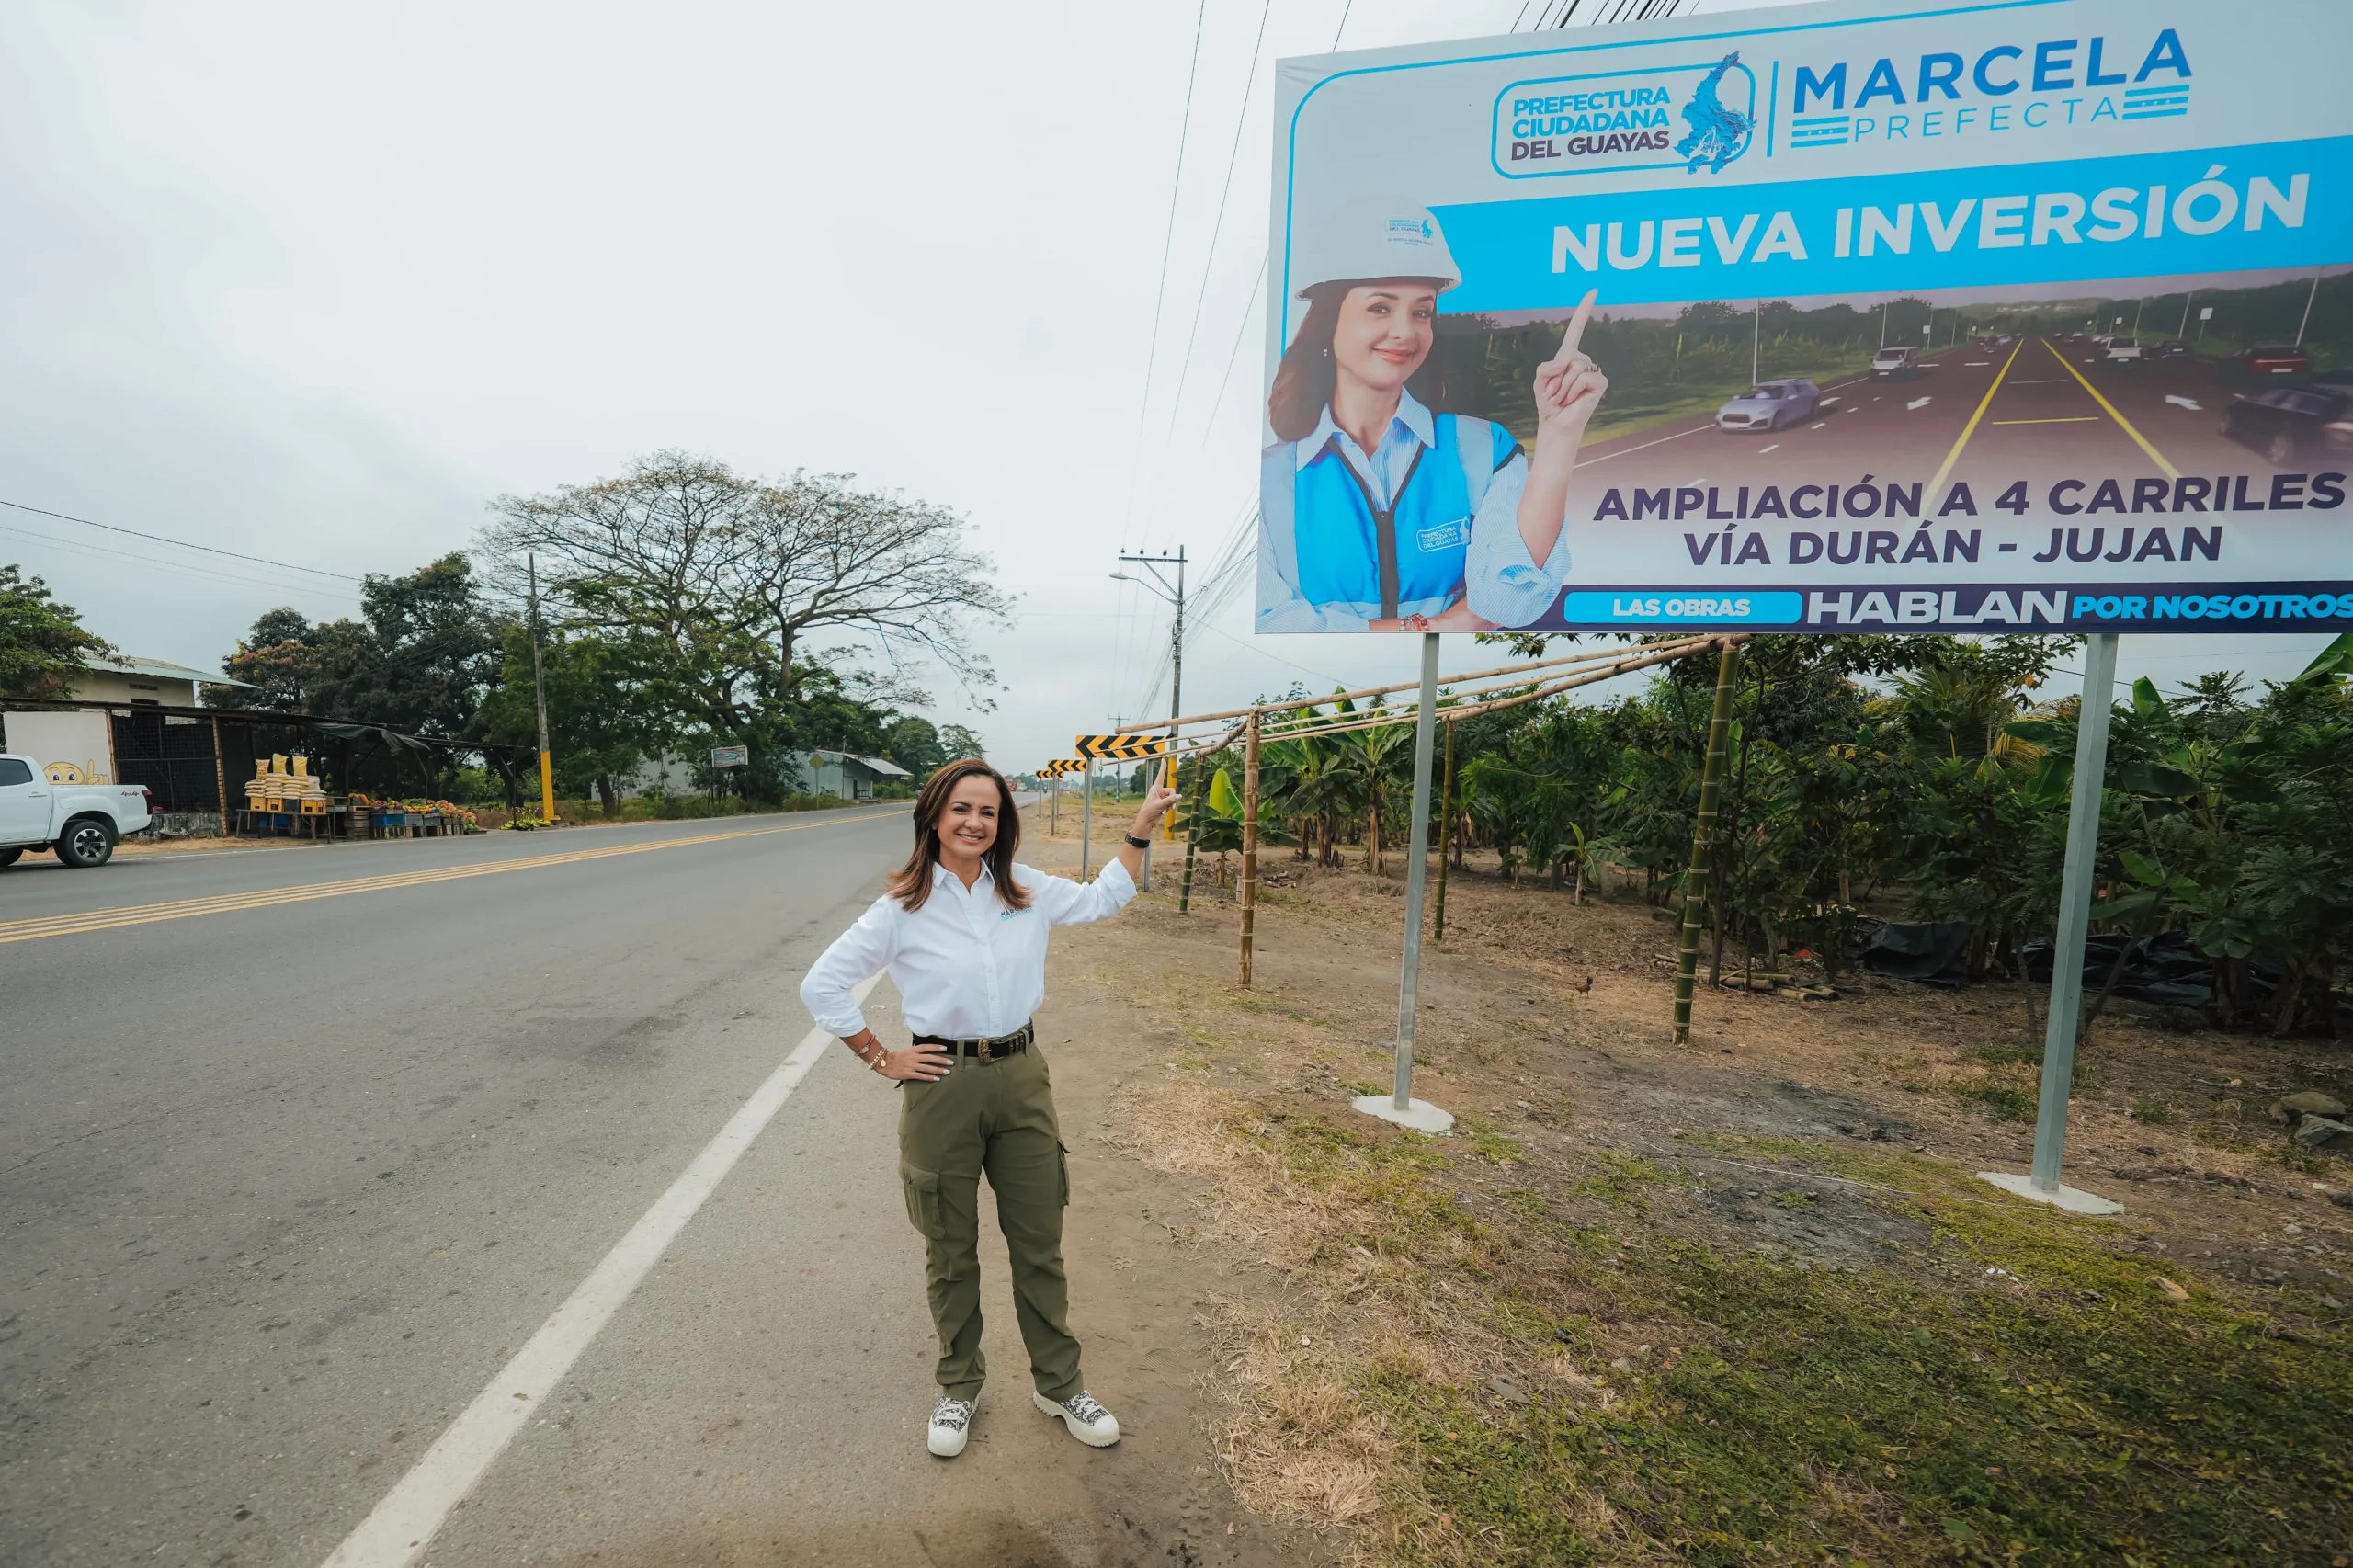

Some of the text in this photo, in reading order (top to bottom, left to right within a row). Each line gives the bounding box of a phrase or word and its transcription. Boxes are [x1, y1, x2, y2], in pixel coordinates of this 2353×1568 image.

[1794, 28, 2192, 114] MARCELA
[1512, 108, 1670, 139] CIUDADANA
[1513, 86, 1671, 118] PREFECTURA
[1854, 96, 2118, 142] PREFECTA
[1511, 130, 1670, 161] DEL GUAYAS
[1552, 164, 2311, 274] NUEVA INVERSIÓN
[1593, 472, 2346, 521] AMPLIACIÓN A 4 CARRILES
[1684, 520, 2222, 565] VÍA DURÁN - JUJAN
[1613, 590, 2353, 624] LAS OBRAS HABLAN POR NOSOTROS
